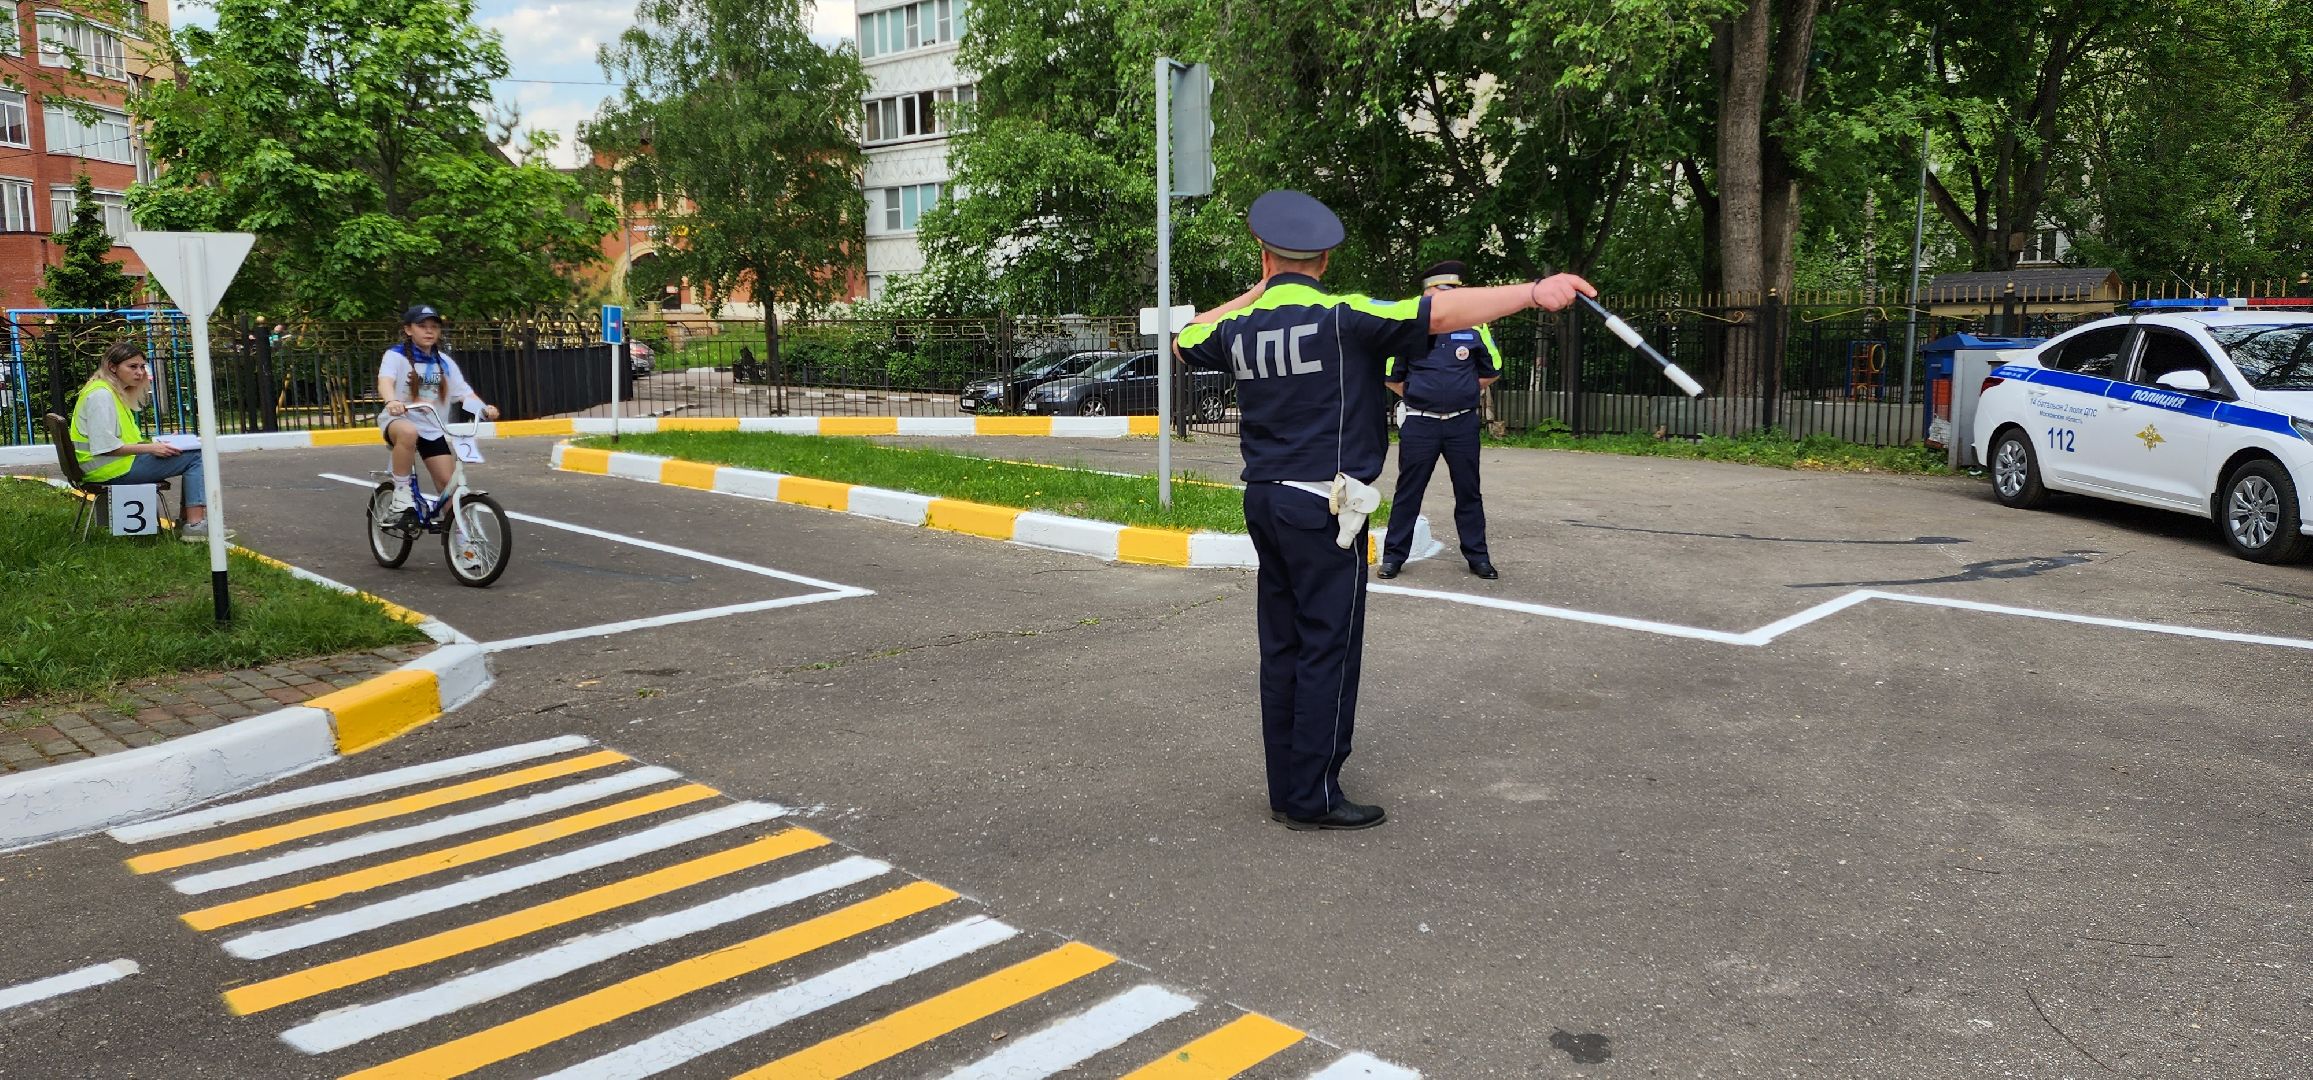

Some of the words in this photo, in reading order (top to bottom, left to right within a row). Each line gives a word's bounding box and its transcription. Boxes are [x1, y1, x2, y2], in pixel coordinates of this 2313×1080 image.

[1230, 322, 1323, 380] ДПС
[2131, 389, 2187, 408] ПОЛИЦИЯ
[2064, 404, 2069, 412] 2
[2084, 407, 2097, 417] ДПС
[459, 443, 478, 459] 2
[2048, 426, 2075, 453] 112
[123, 500, 147, 534] 3
